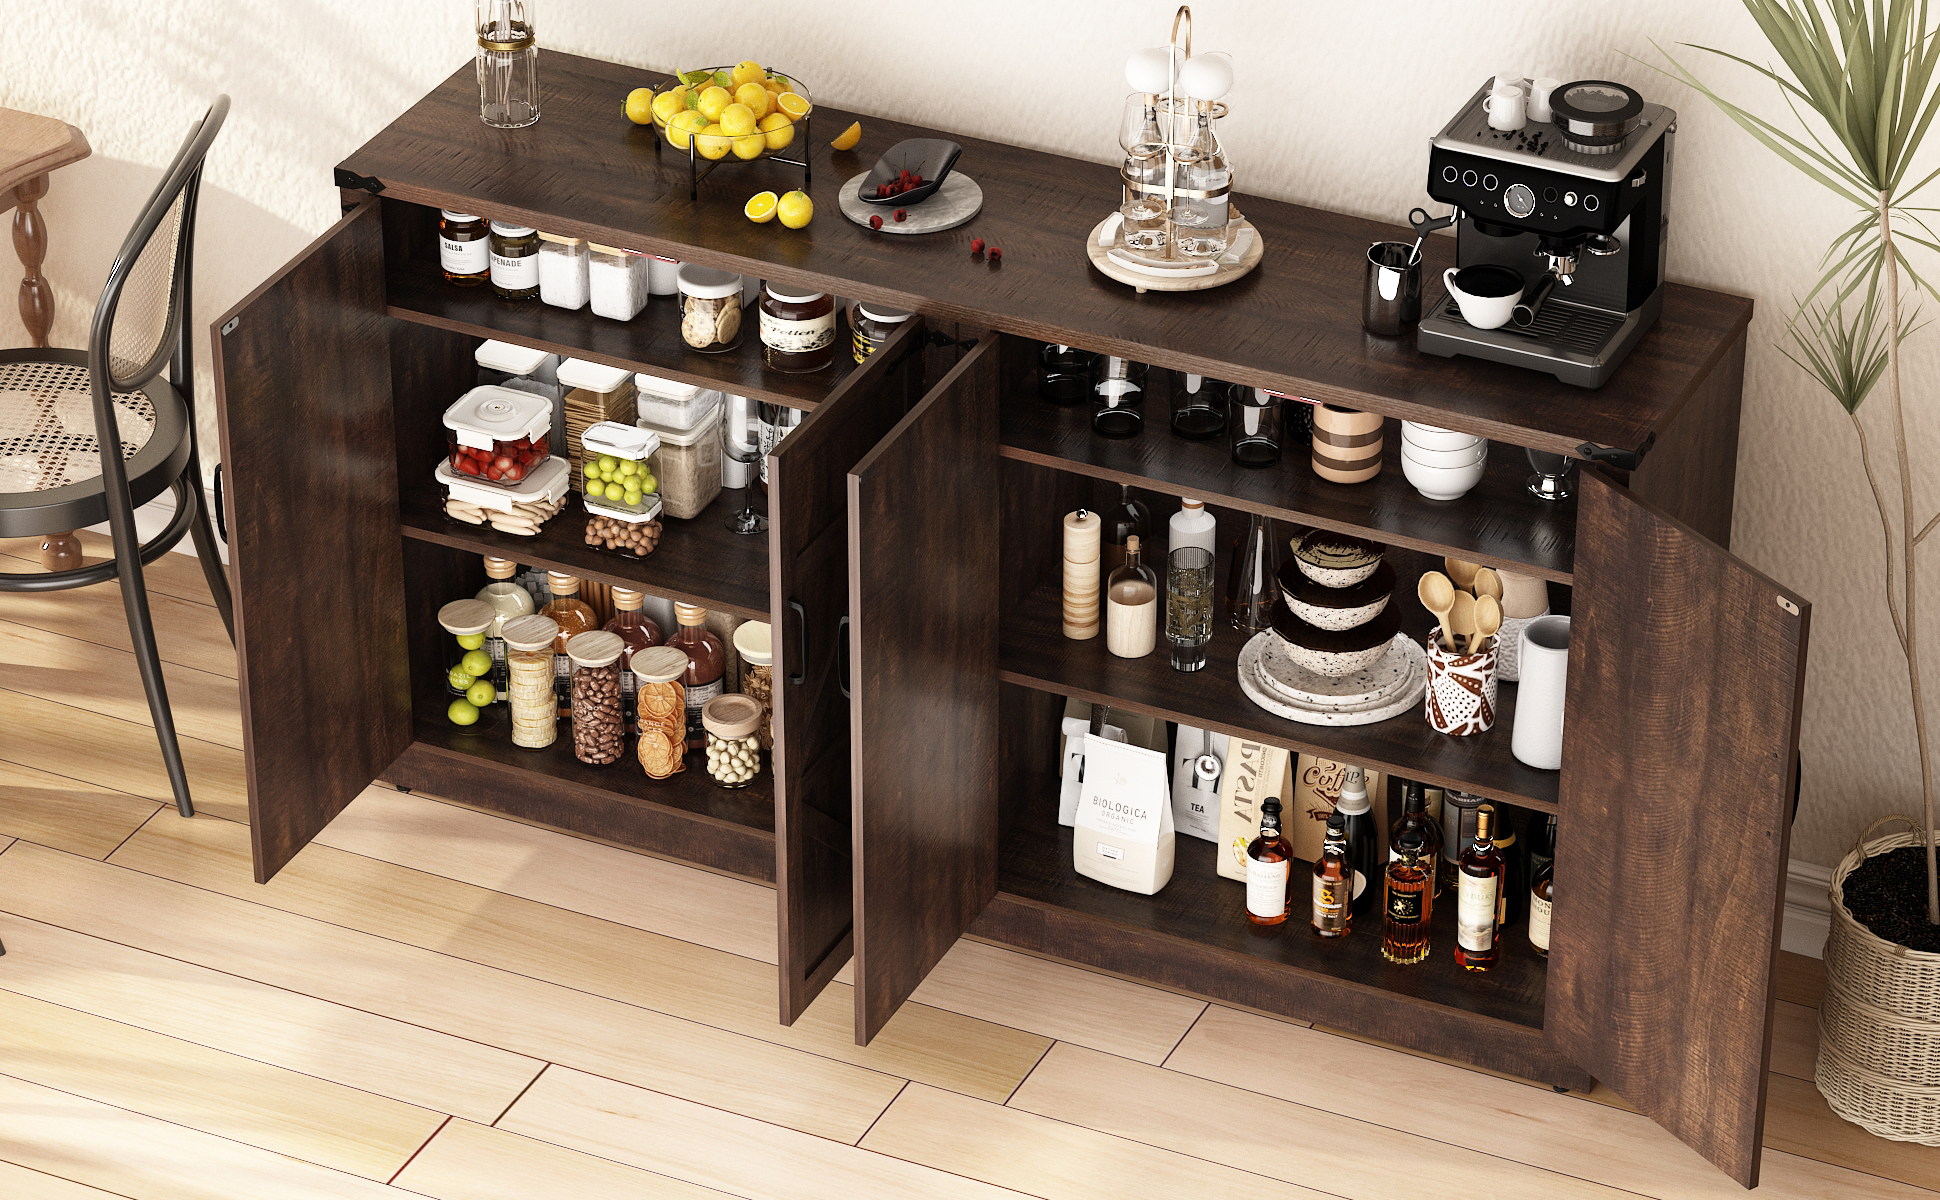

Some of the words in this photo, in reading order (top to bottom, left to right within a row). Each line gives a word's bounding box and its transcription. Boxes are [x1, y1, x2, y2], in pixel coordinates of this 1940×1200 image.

[444, 242, 463, 252] SALSA
[1303, 766, 1370, 792] Coff
[1093, 796, 1147, 820] BIOLOGICA
[1190, 803, 1204, 813] TEA
[1101, 810, 1134, 825] ORGANIC
[1533, 895, 1551, 909] MON
